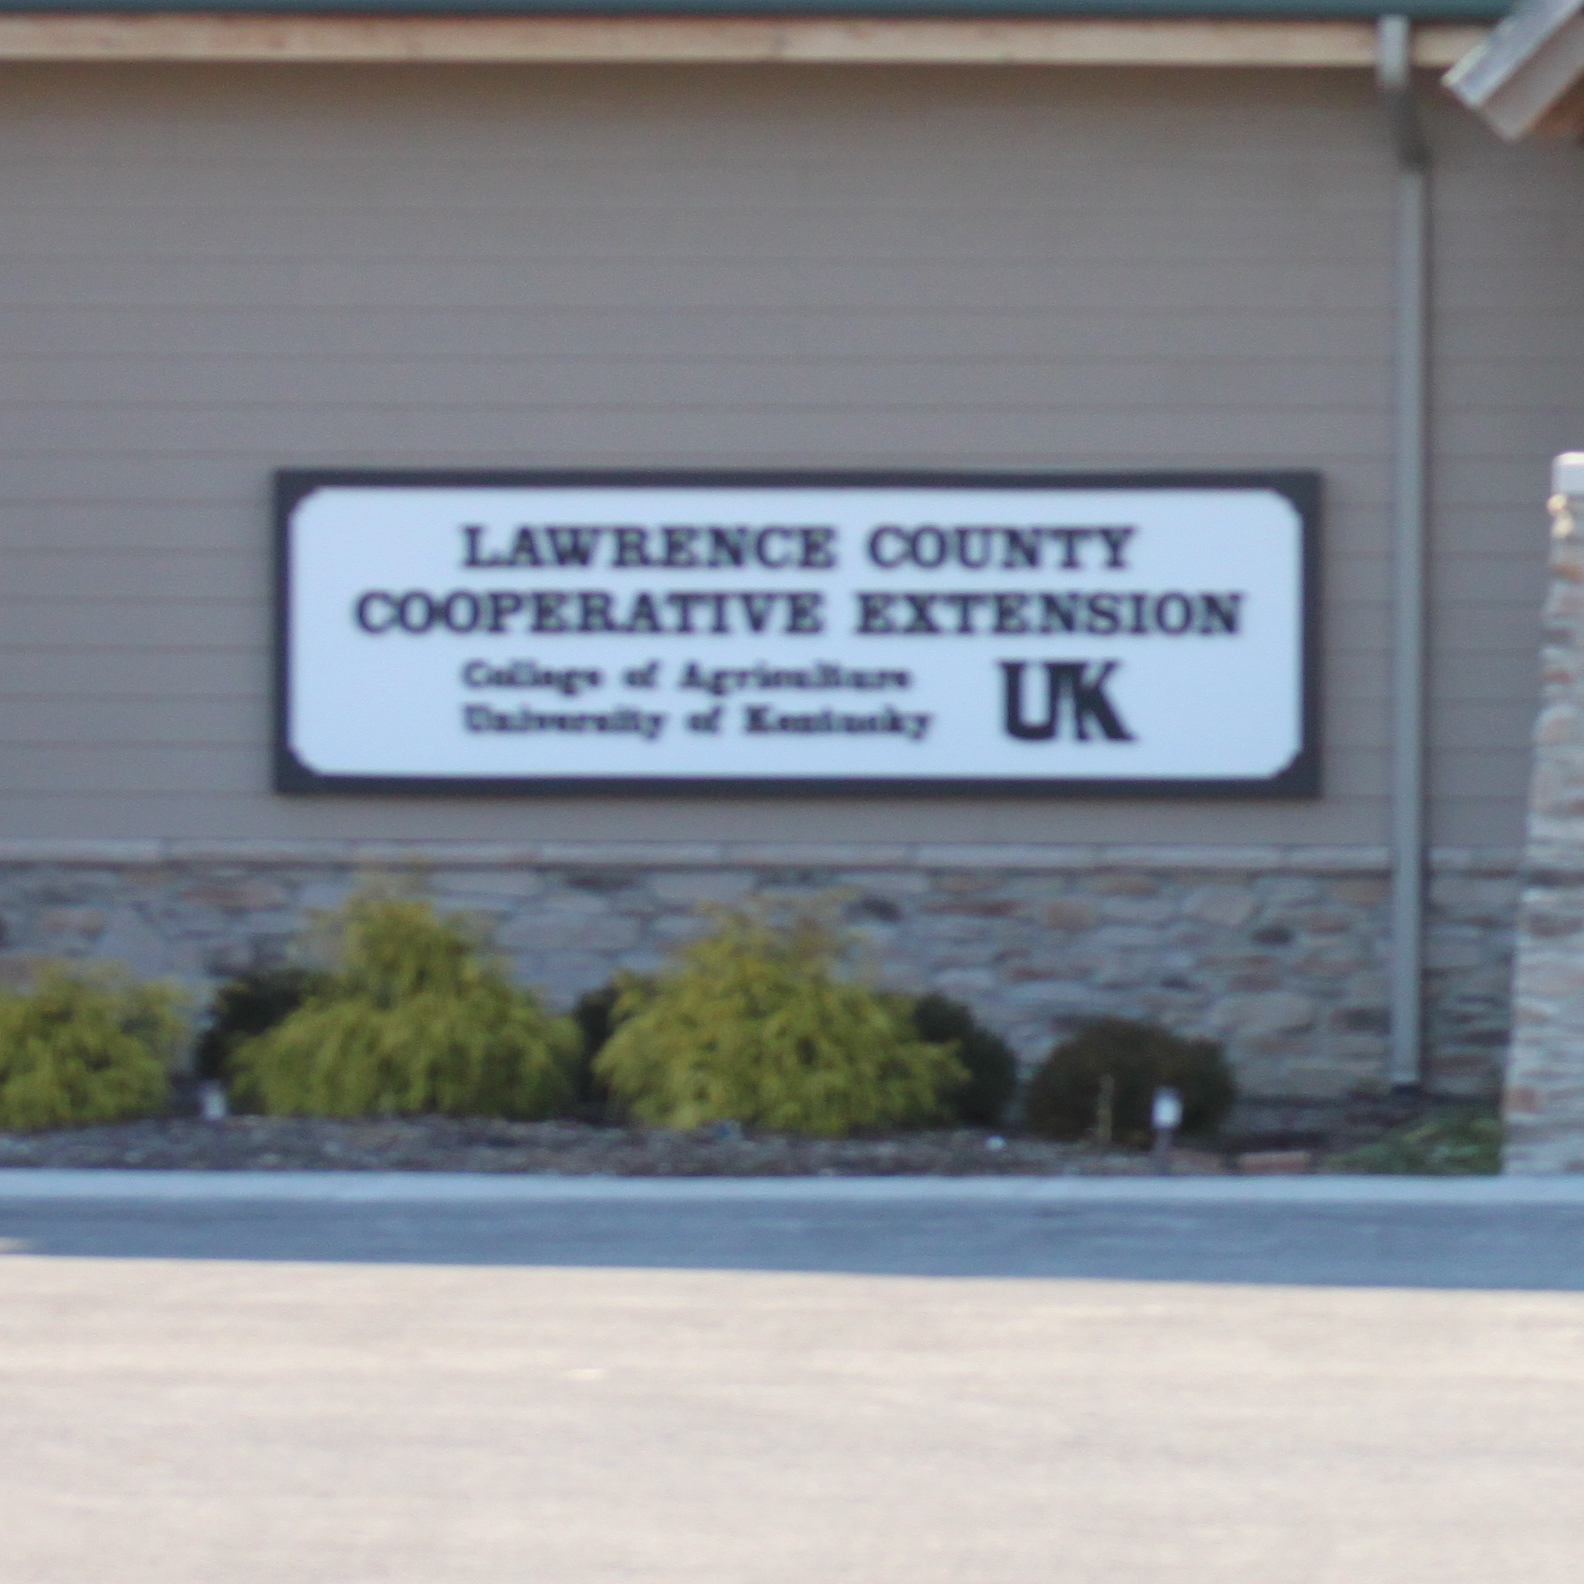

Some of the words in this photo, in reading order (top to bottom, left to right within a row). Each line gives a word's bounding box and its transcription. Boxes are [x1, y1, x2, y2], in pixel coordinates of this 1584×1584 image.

[462, 525, 838, 571] LAWRENCE
[865, 524, 1137, 571] COUNTY
[352, 589, 825, 637] COOPERATIVE
[854, 590, 1244, 638] EXTENSION
[461, 660, 604, 699] College
[622, 660, 661, 691] of
[678, 660, 914, 699] Agriculture
[996, 658, 1139, 745] UK
[462, 703, 667, 742] University
[685, 703, 725, 735] of
[743, 703, 934, 743] Kentucky
